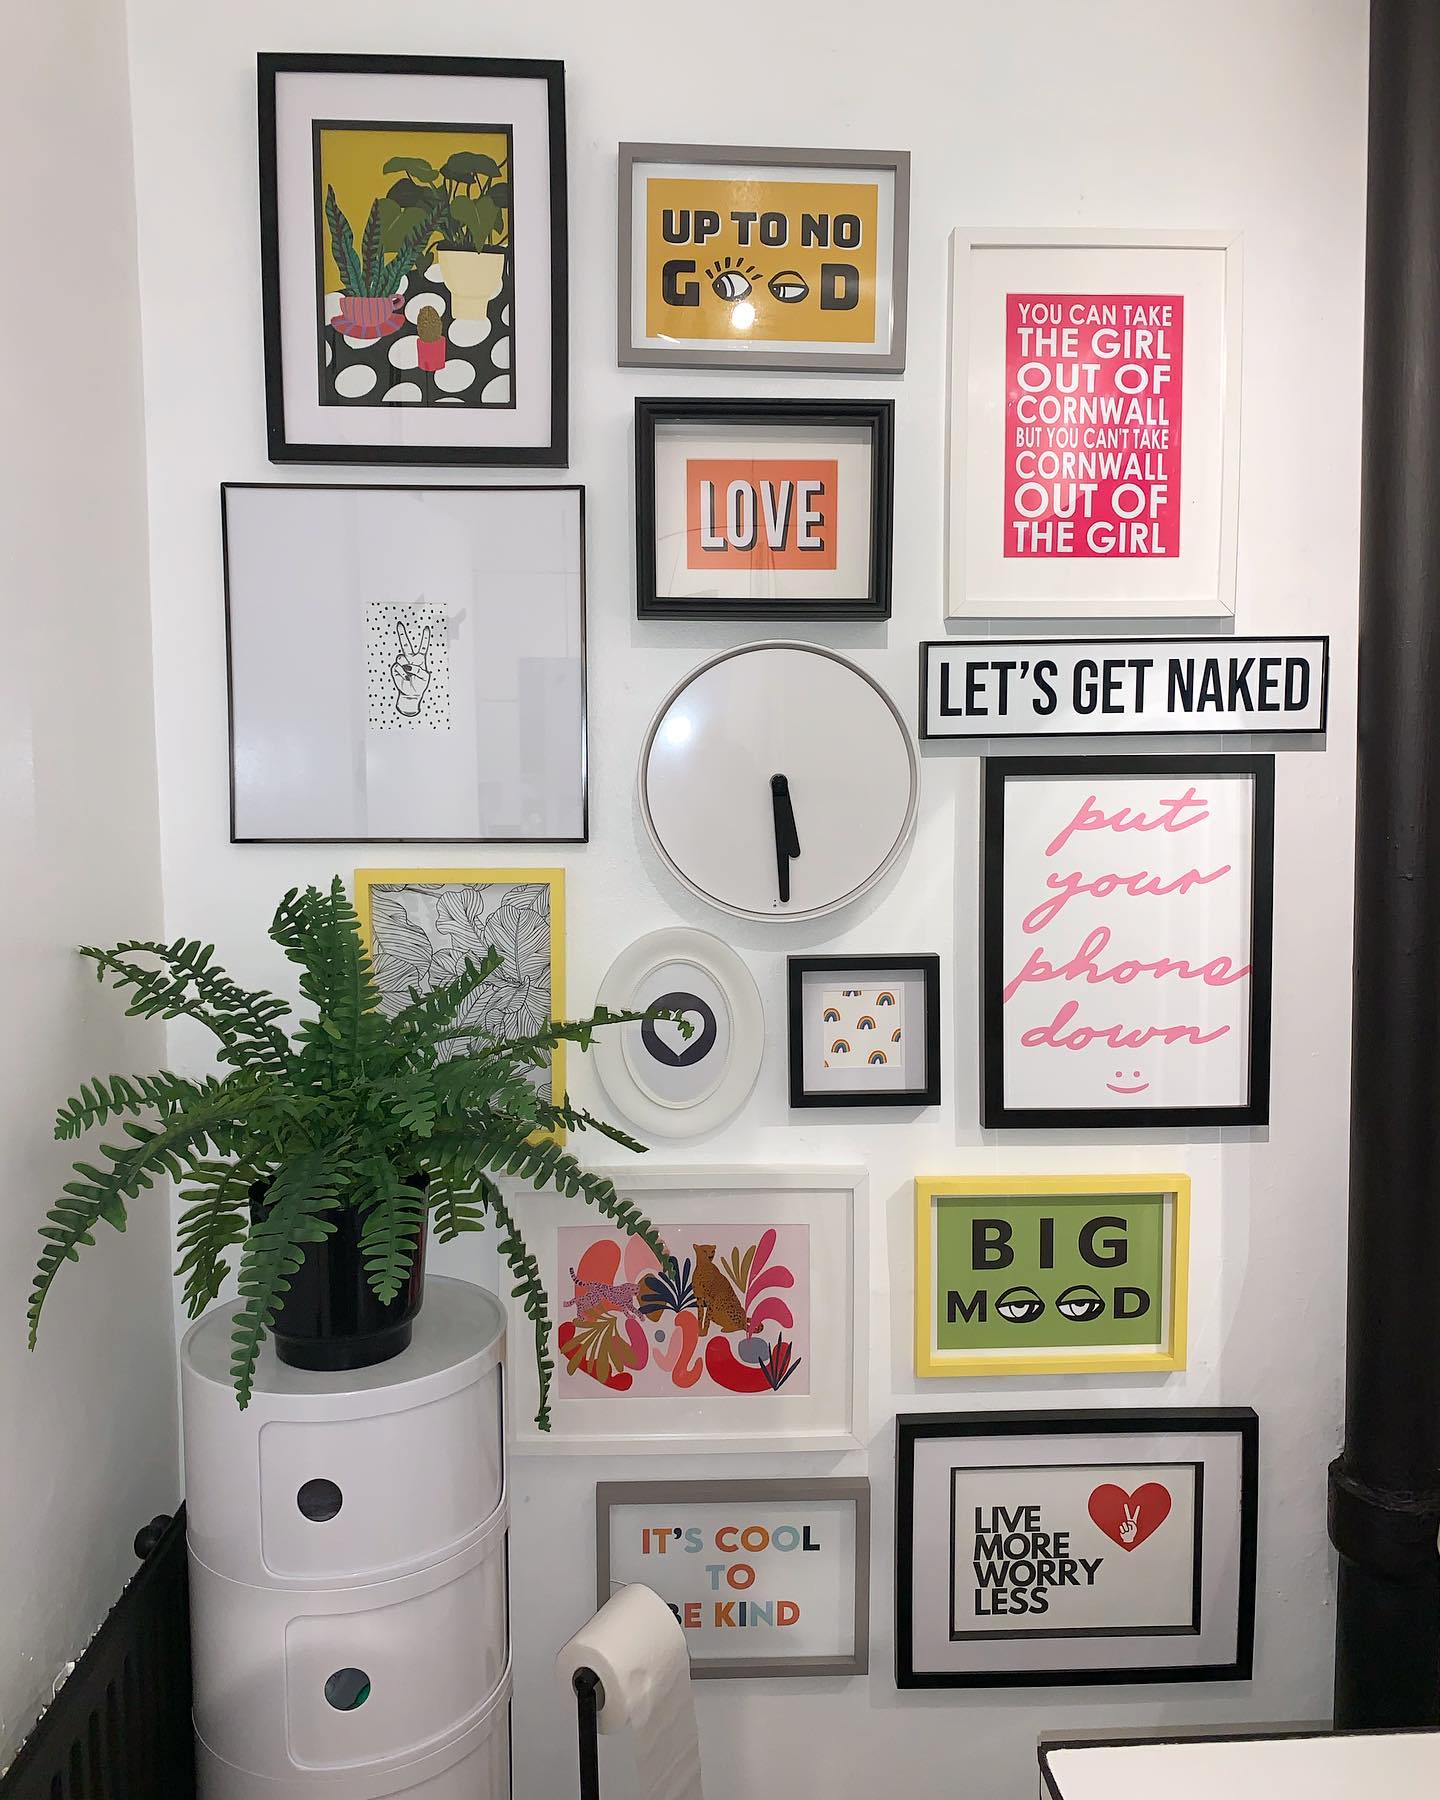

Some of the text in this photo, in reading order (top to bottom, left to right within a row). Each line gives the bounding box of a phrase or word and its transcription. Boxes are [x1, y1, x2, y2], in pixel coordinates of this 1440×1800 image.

[662, 209, 862, 250] UP TO NO
[1018, 303, 1173, 327] YOU CAN TAKE
[1017, 328, 1171, 359] THE GIRL
[1017, 362, 1171, 394] OUT OF
[1017, 395, 1169, 425] CORNWALL
[1016, 427, 1169, 449] BUT YOU CAN'T TAKE
[1016, 450, 1168, 481] CORNWALL
[700, 479, 826, 552] LOVE
[1014, 482, 1168, 519] OUT OF
[1013, 522, 1166, 554] THE GIRL
[1072, 658, 1154, 714] GET
[1167, 657, 1310, 713] NAKED
[1045, 787, 1210, 856] put
[1022, 865, 1231, 934] your
[1002, 926, 1253, 1003] phone
[1020, 1001, 1230, 1050] down
[972, 1216, 1128, 1270] BIG
[975, 1505, 1041, 1533] LIVE
[715, 1525, 821, 1553] COOL
[974, 1532, 1070, 1561] MORE
[705, 1563, 756, 1590] TO
[973, 1558, 1104, 1588] WORRY
[715, 1601, 800, 1627] KIND
[975, 1587, 1049, 1615] LESS
